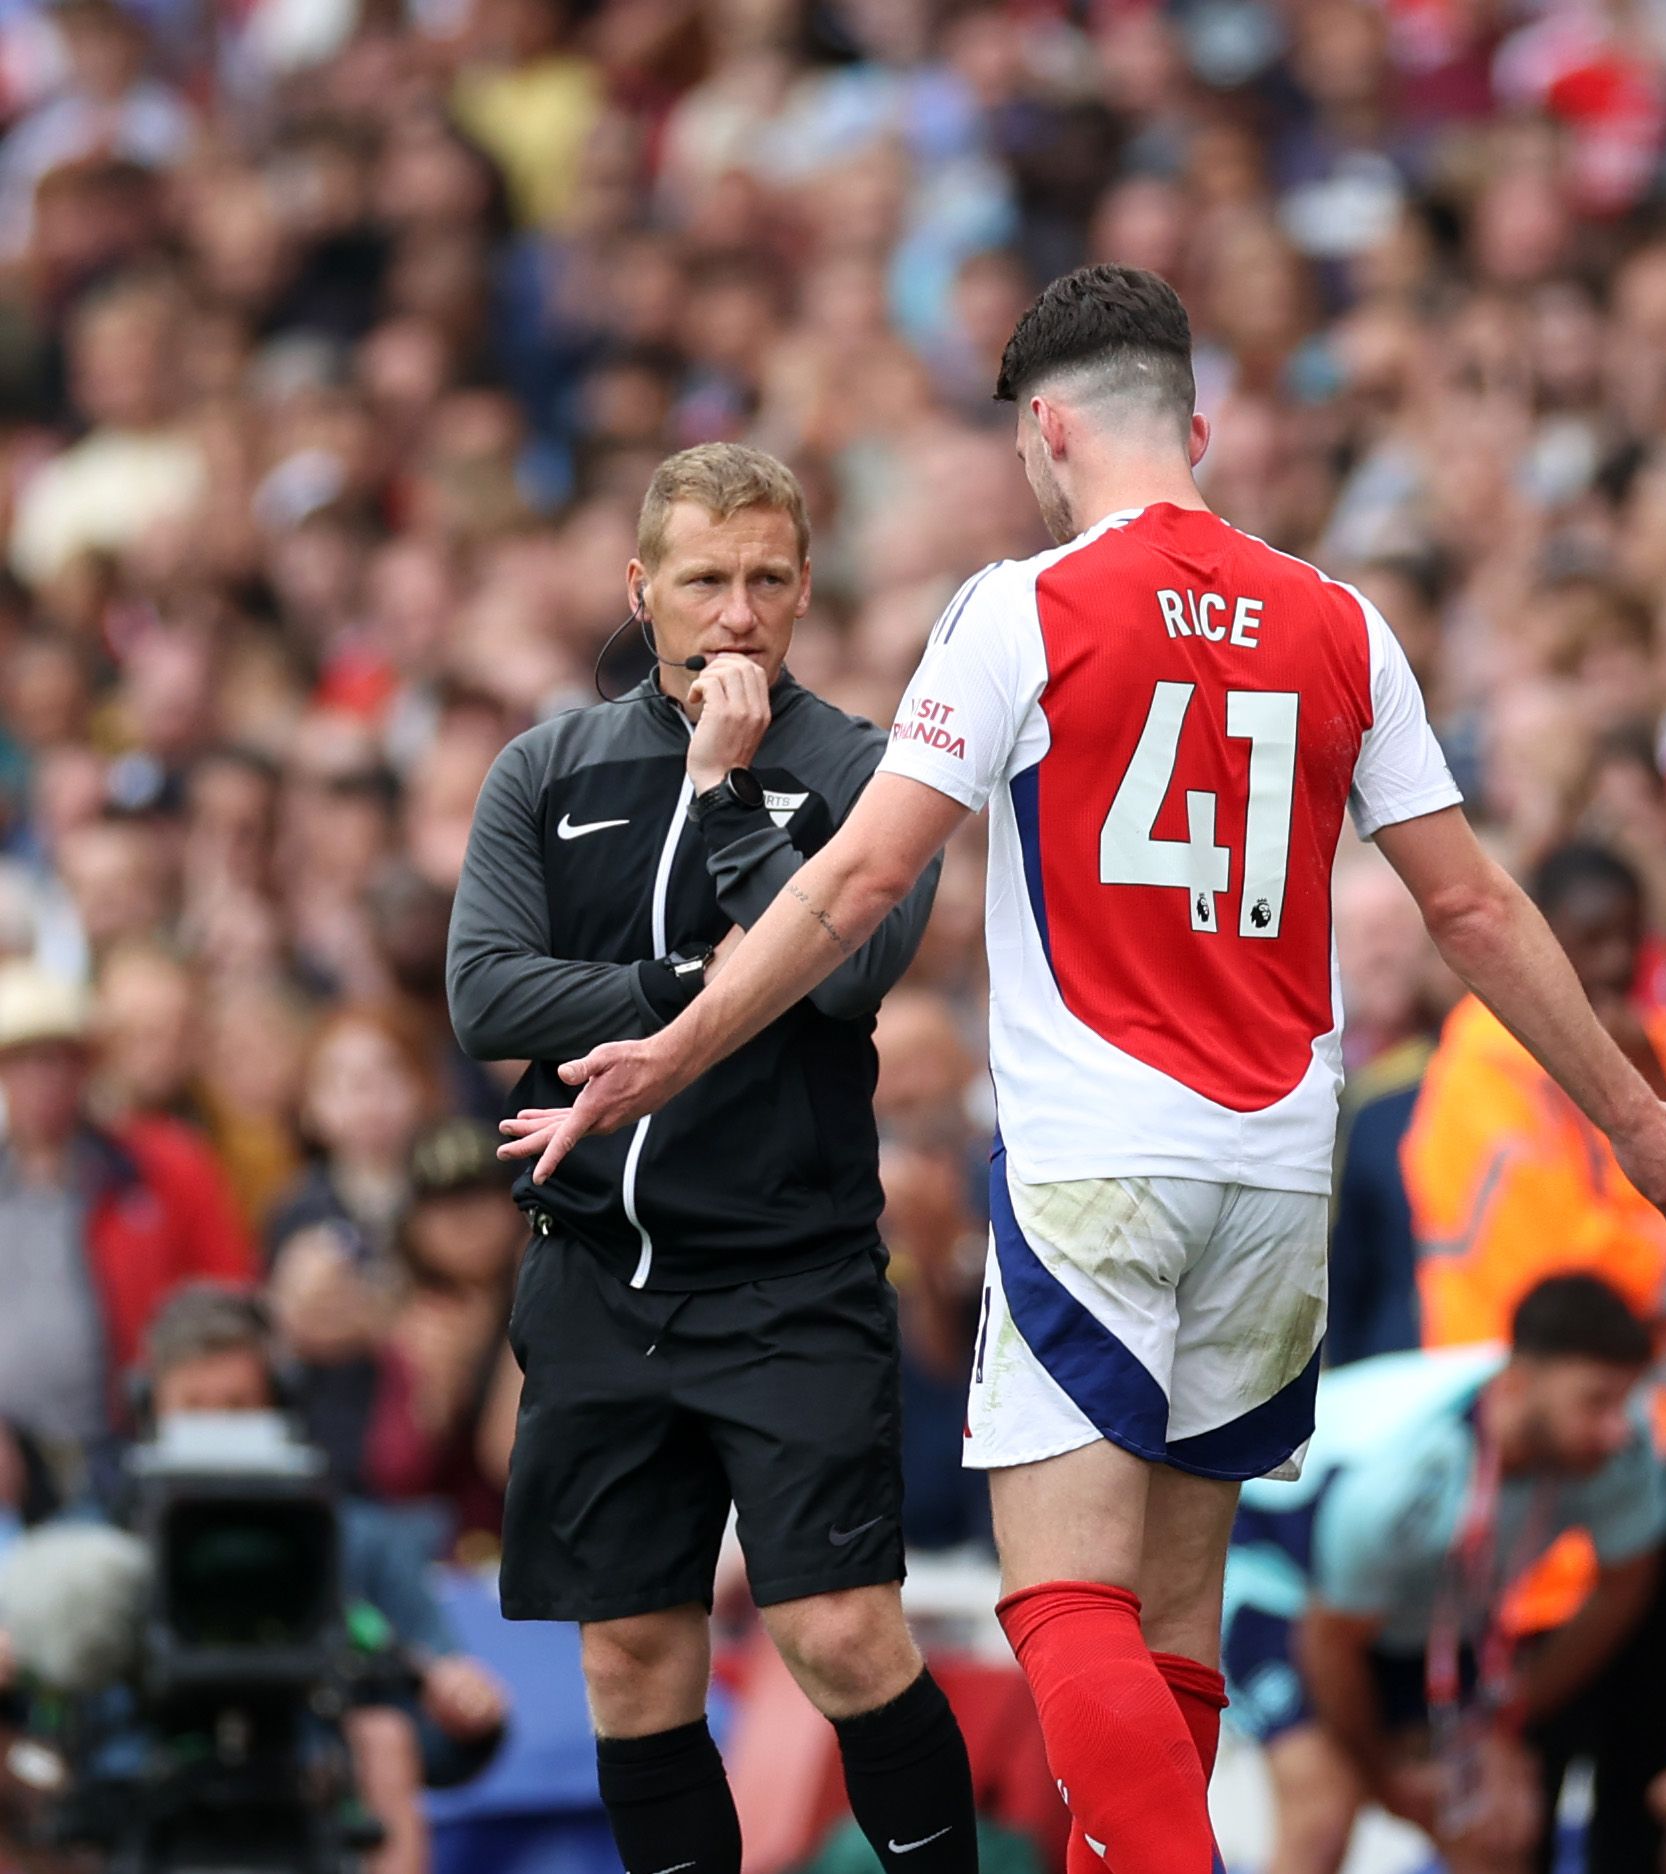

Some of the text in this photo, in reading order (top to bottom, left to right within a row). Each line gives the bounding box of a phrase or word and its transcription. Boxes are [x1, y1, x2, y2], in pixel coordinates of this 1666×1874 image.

[1156, 588, 1265, 649] RICE
[911, 698, 955, 725] VSIT
[892, 721, 966, 761] RNDA
[764, 794, 791, 807] RTS
[1099, 680, 1300, 938] 41
